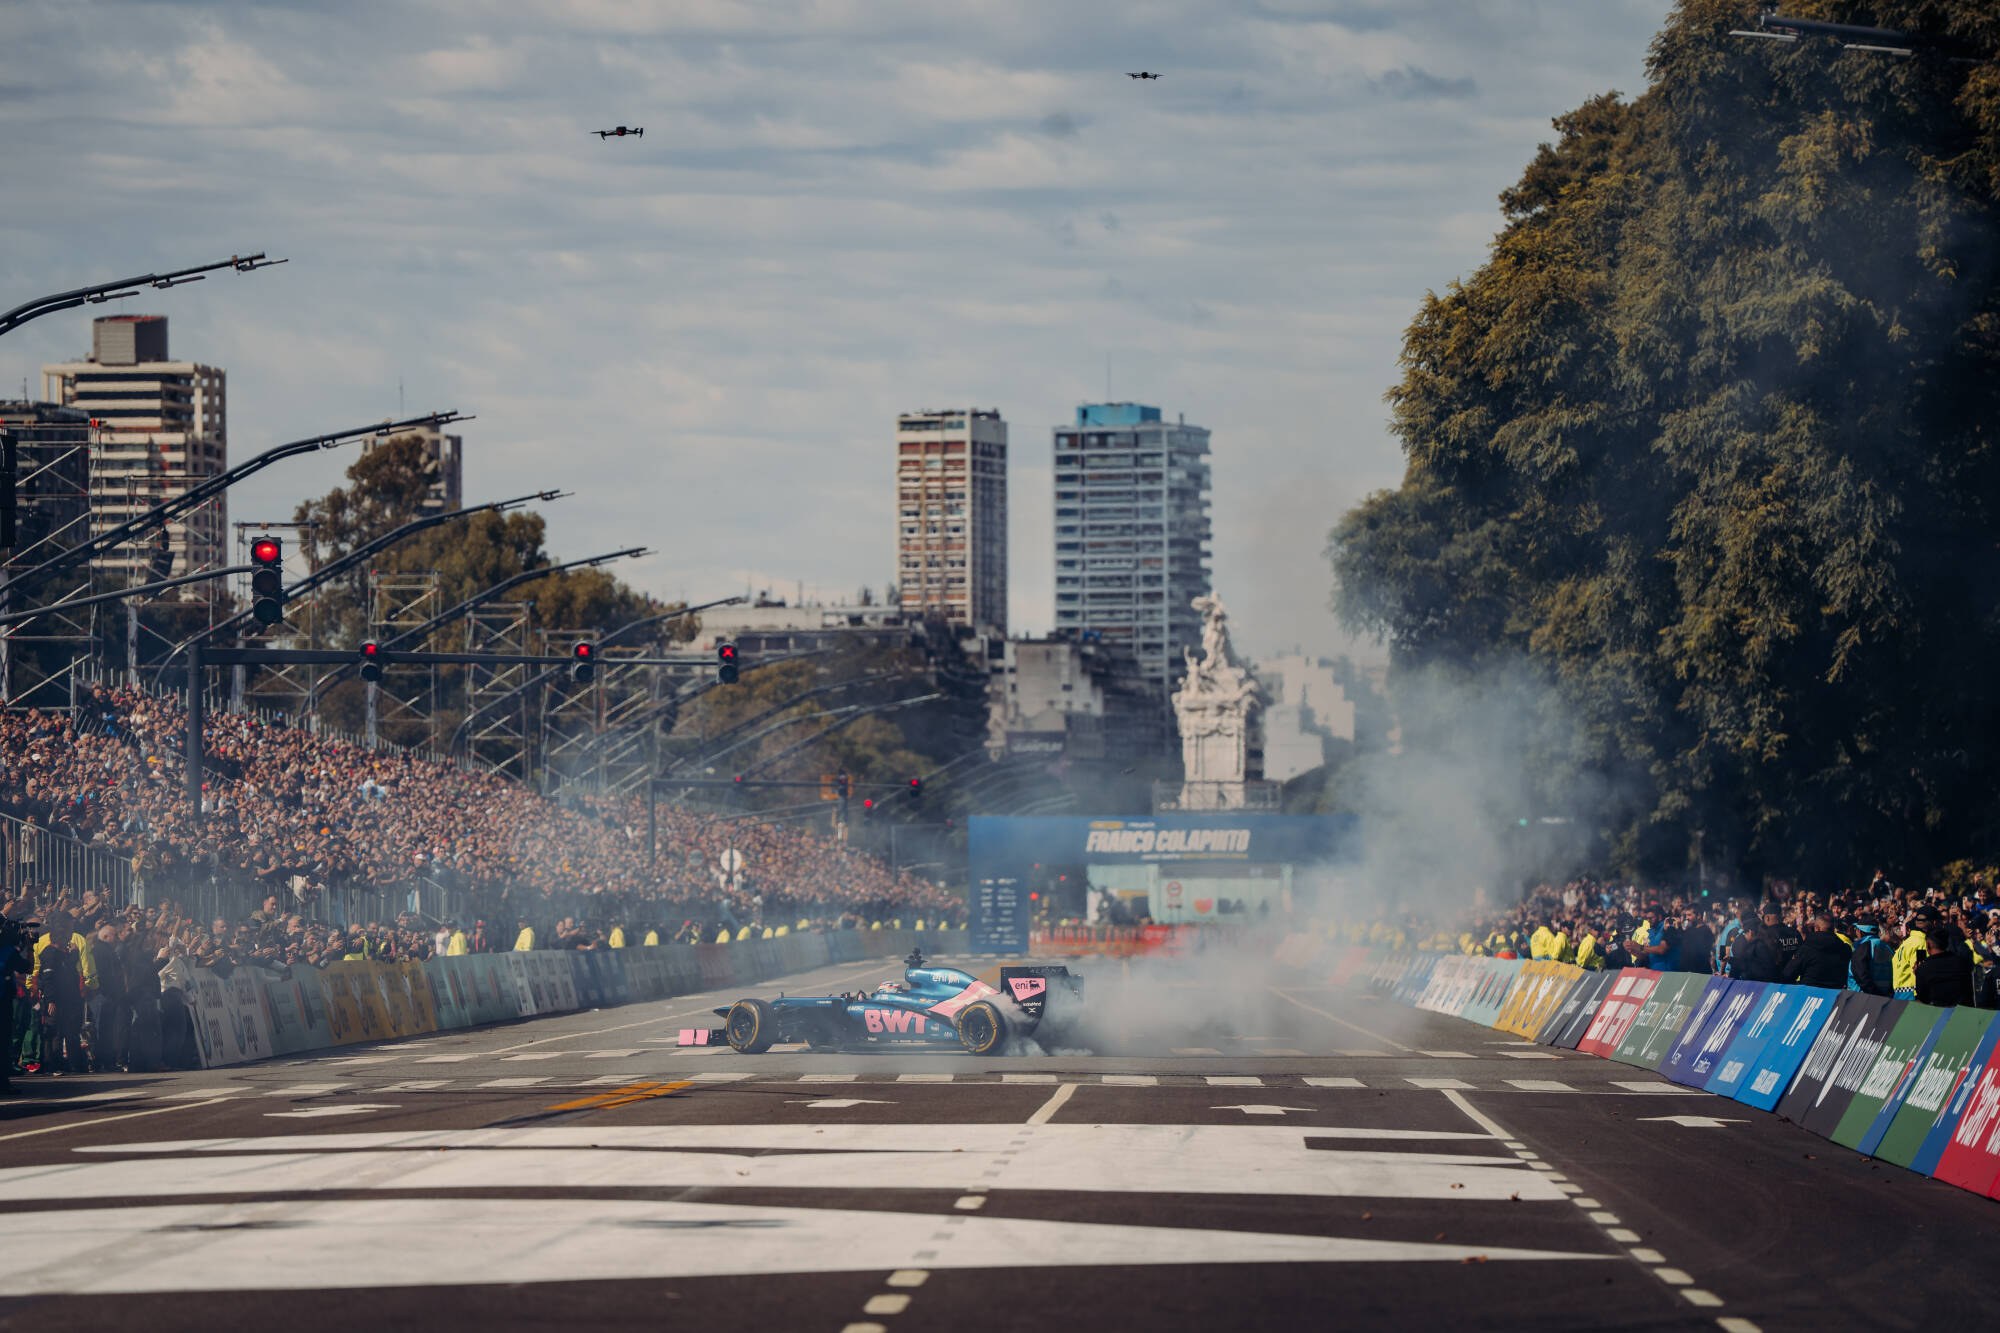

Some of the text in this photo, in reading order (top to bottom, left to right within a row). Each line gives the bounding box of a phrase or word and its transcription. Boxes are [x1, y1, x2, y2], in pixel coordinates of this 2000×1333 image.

[1086, 829, 1251, 852] FRANCO COLAPINTO
[1015, 981, 1029, 990] eni
[864, 1009, 929, 1034] BWT
[1747, 992, 1787, 1038] YPF
[1781, 996, 1824, 1047] YPF
[1804, 1020, 1849, 1082] motorola
[1834, 1028, 1887, 1092] motorola
[1859, 1045, 1905, 1100] Heineken
[1905, 1052, 1955, 1112] Heineken
